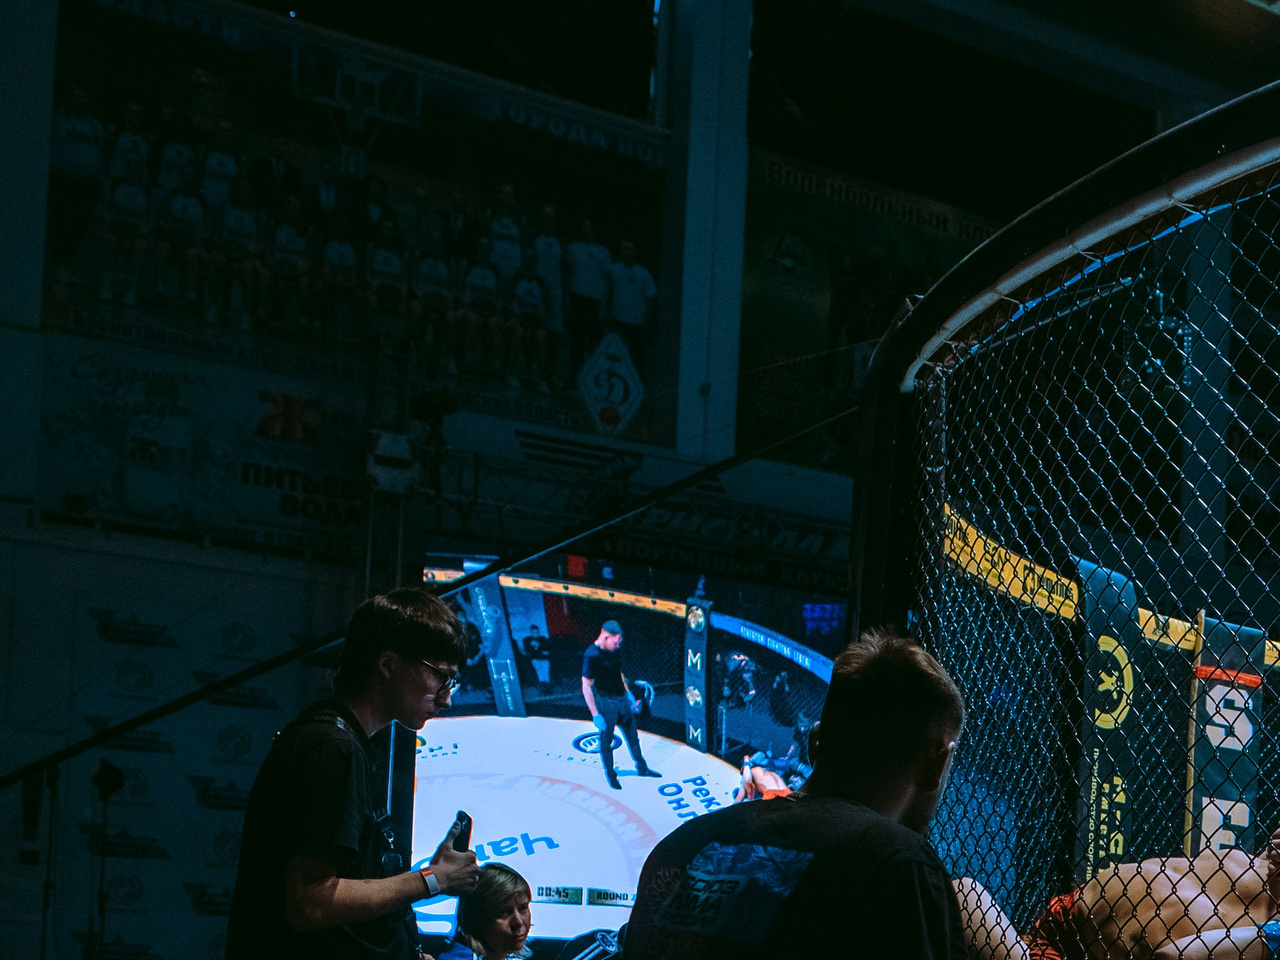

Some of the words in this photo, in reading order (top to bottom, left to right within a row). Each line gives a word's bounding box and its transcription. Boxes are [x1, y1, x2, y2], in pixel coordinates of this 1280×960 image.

[279, 494, 361, 527] ВОДА
[682, 775, 724, 814] Рек
[537, 886, 569, 899] 00:45
[596, 891, 629, 901] ROUND
